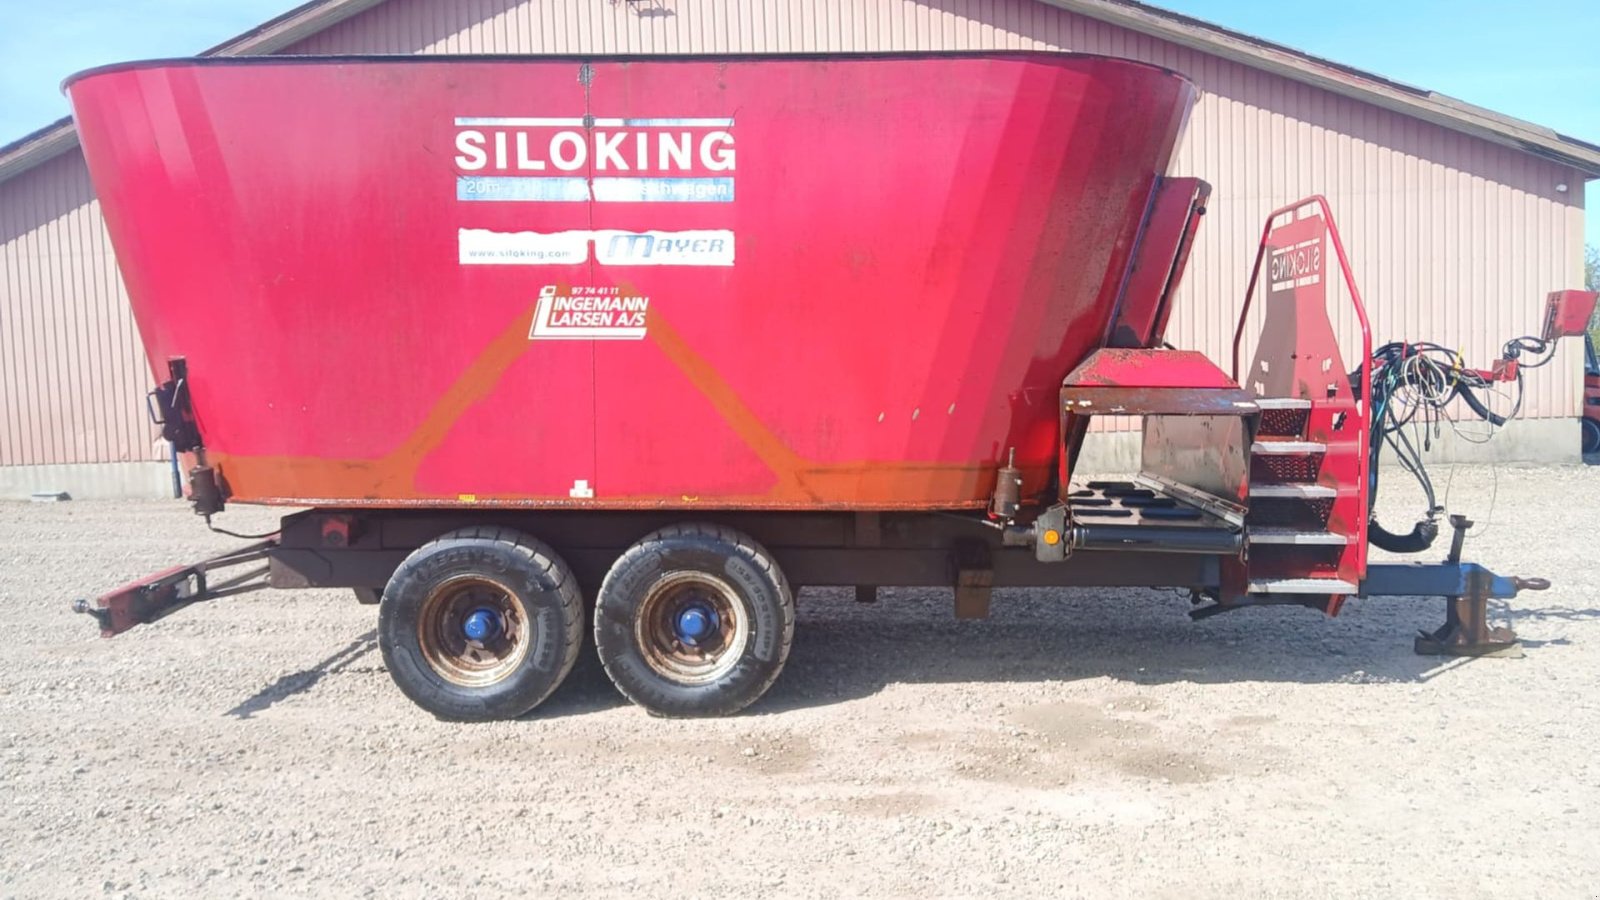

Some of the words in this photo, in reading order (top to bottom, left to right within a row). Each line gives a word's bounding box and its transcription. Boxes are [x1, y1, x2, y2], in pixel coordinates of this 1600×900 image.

[455, 130, 736, 171] SILOKING
[571, 286, 584, 295] 97
[585, 286, 596, 295] 74
[597, 286, 608, 295] 41
[610, 286, 619, 295] 11
[550, 311, 613, 326] LARSEN
[615, 311, 647, 326] A/S
